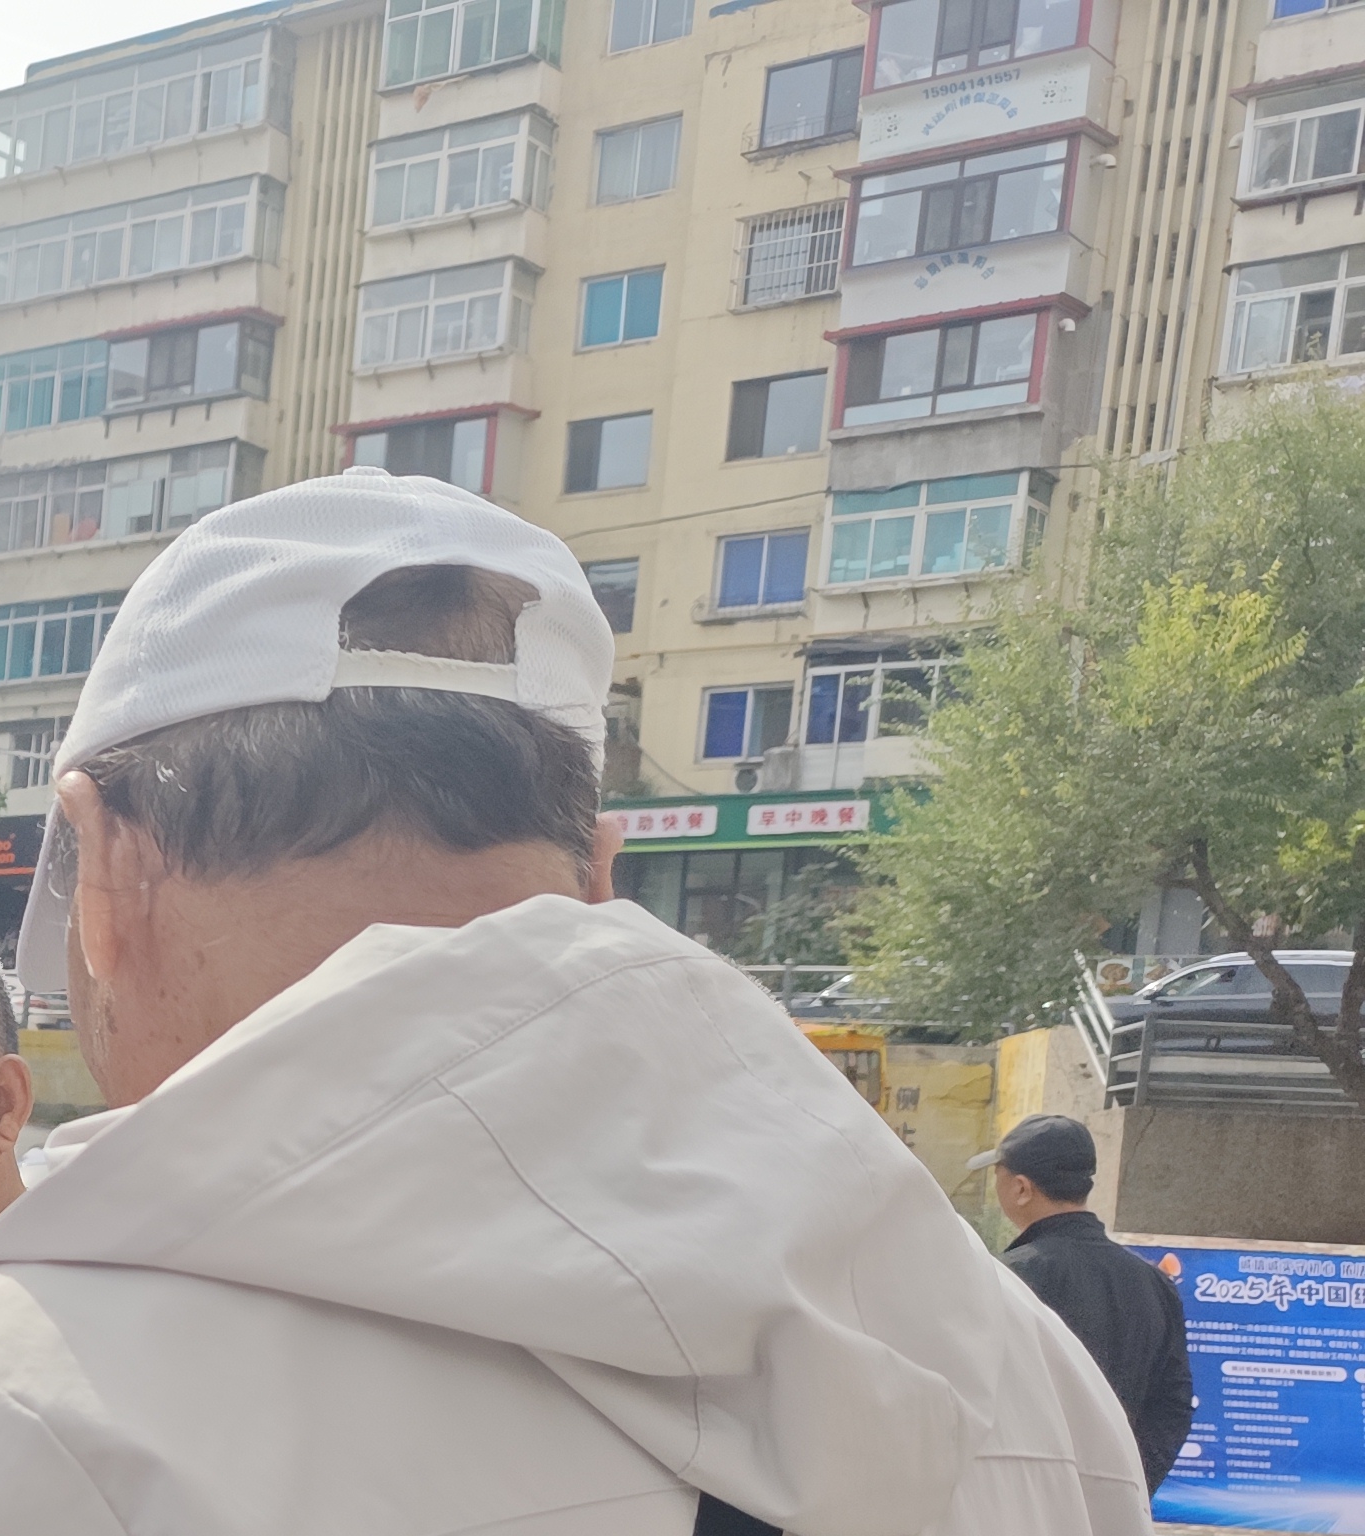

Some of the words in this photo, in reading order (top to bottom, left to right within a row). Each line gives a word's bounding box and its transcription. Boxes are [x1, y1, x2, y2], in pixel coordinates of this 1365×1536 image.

[922, 69, 1021, 100] 15904141557
[760, 806, 857, 826] 早中晚餐
